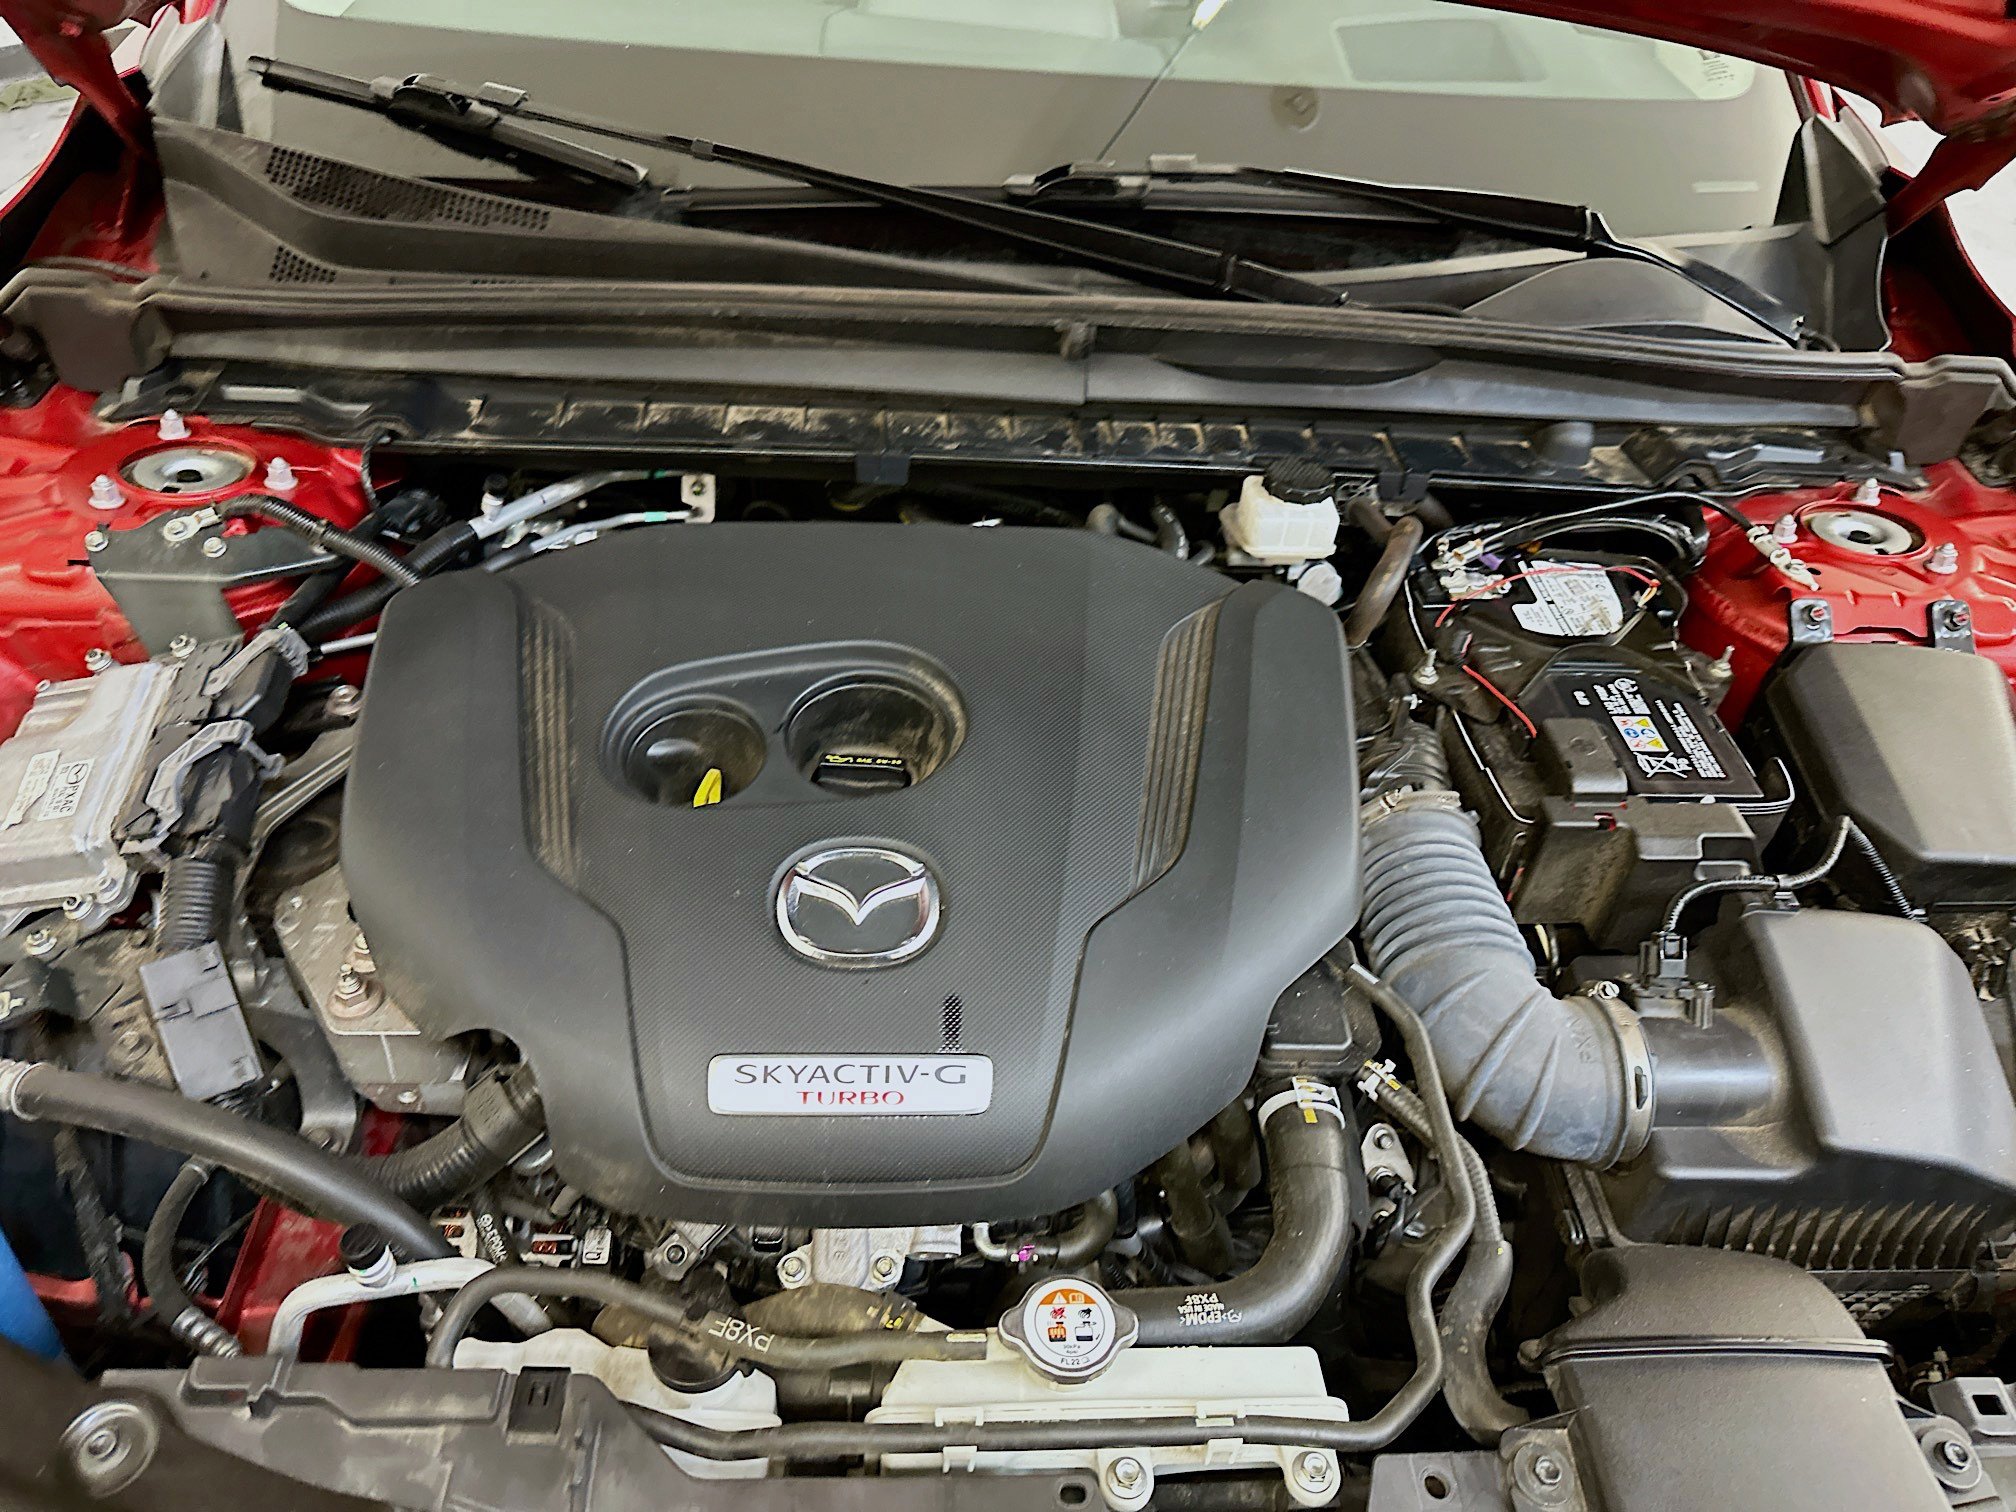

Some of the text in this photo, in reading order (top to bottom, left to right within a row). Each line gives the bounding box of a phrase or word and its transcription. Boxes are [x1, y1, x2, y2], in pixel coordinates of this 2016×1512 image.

[734, 1064, 967, 1084] SKYACTIV-G
[796, 1090, 905, 1105] TURBO
[1177, 1303, 1225, 1315] MADE IN USA
[708, 1317, 776, 1354] PX8F
